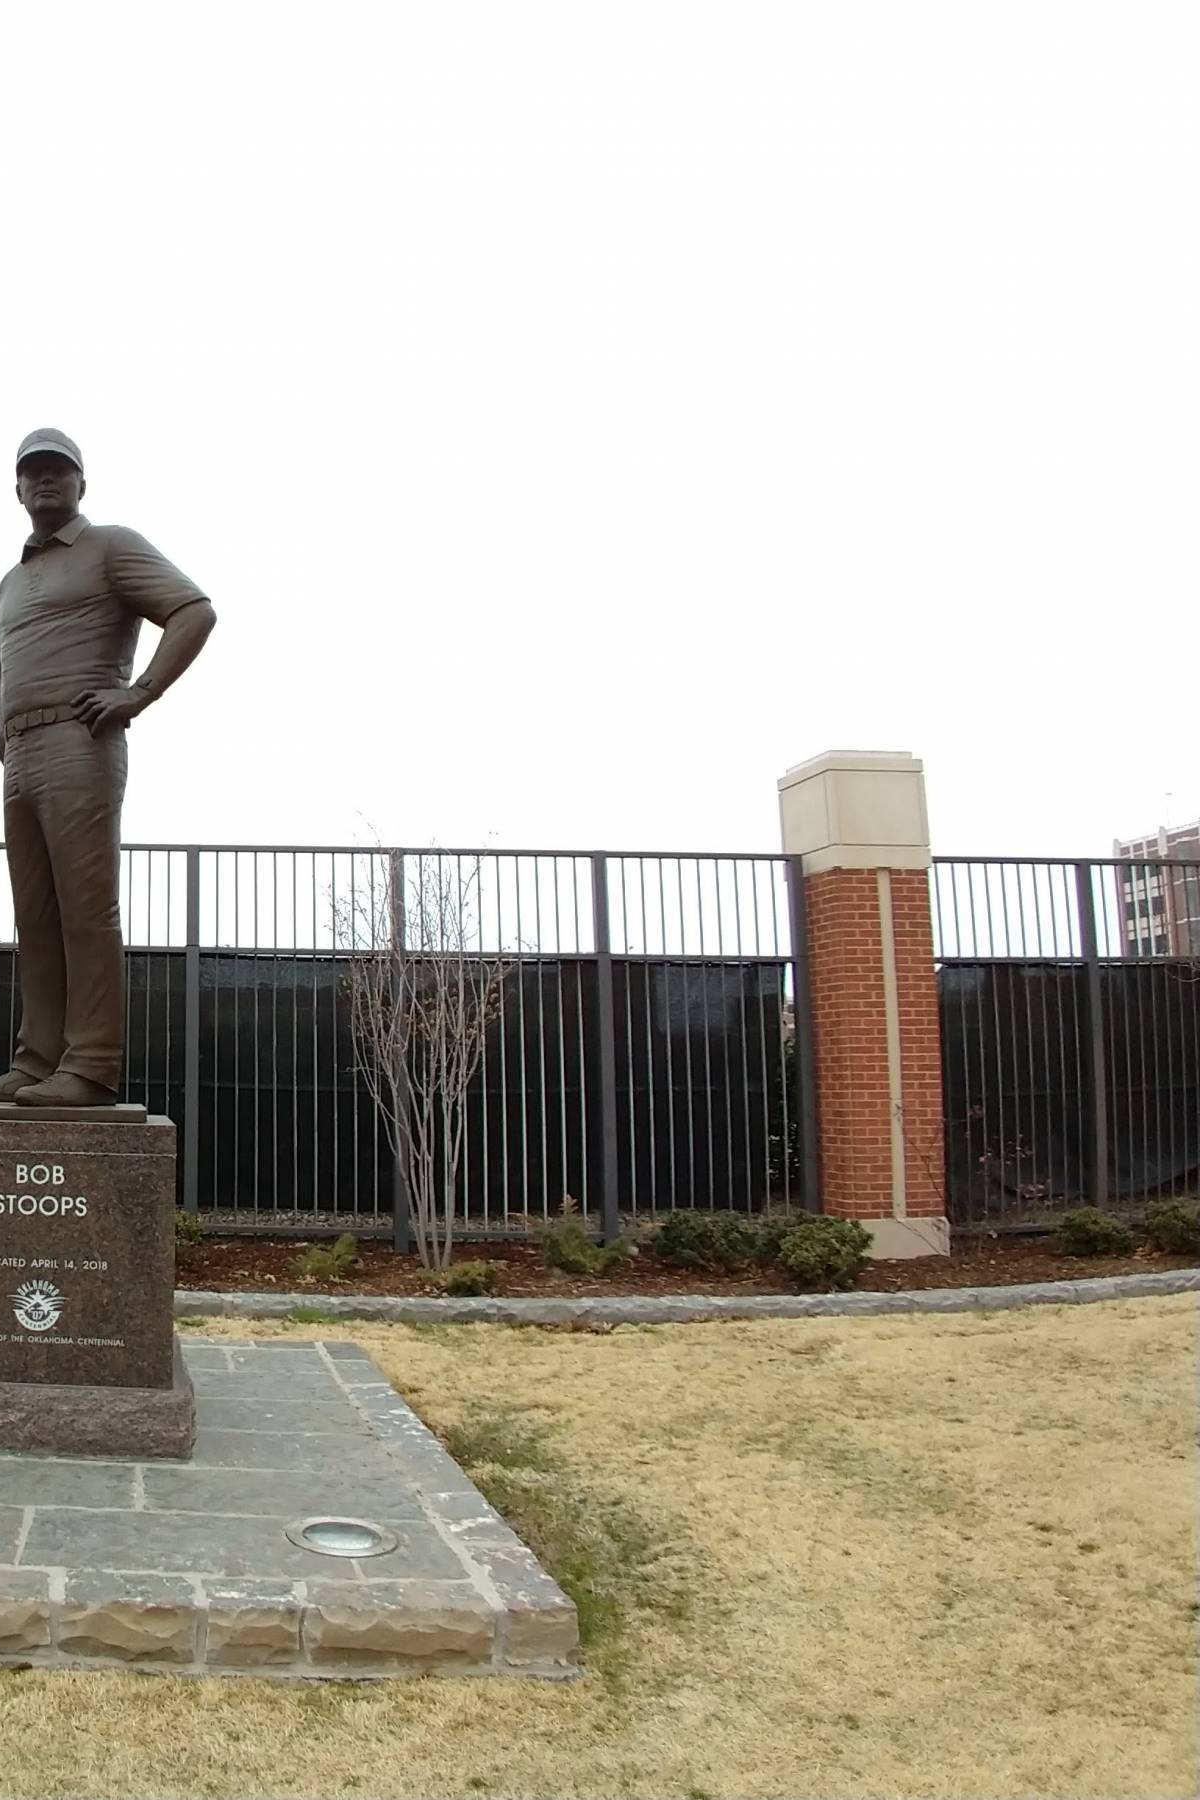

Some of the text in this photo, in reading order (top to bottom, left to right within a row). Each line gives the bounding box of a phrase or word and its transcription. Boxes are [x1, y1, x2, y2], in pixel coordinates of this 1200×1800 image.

[16, 1164, 65, 1185] BOB
[30, 1258, 59, 1269] APRIL
[64, 1260, 78, 1271] 14,
[82, 1260, 108, 1271] 2018
[16, 1279, 61, 1297] OKLAHOMA
[17, 1312, 57, 1329] CENTENNIAL
[10, 1335, 23, 1343] THE
[27, 1335, 74, 1345] OKLAHOMA
[77, 1337, 126, 1347] CENTENNIAL
